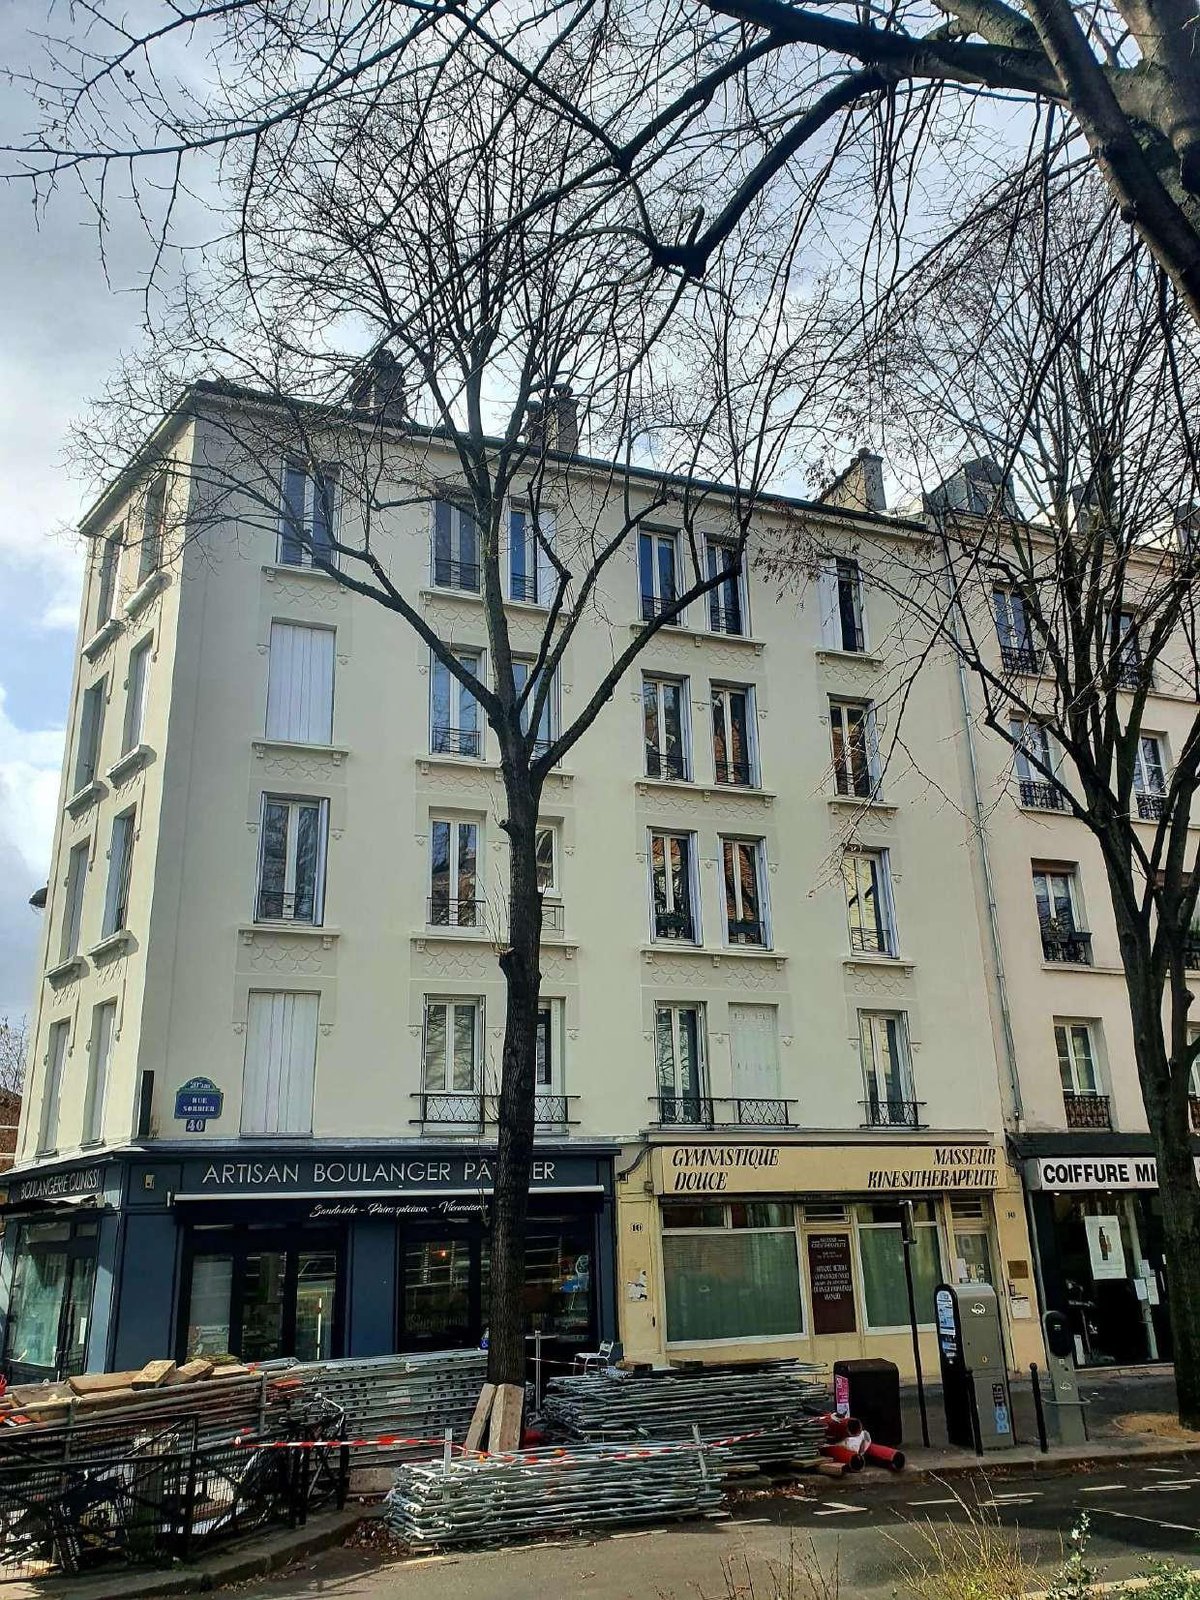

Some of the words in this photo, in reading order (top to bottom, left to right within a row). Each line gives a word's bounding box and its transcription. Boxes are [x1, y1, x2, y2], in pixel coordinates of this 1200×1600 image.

[187, 1119, 203, 1131] 40
[672, 1148, 780, 1170] GYMNASTIQUE
[933, 1148, 997, 1165] MASSEUR
[202, 1163, 299, 1184] ARTISAN
[313, 1161, 450, 1183] BOULANGER
[674, 1171, 728, 1191] DOUCE
[867, 1169, 999, 1188] KINESITHERAPEUTE
[1043, 1163, 1130, 1184] COIFFURE
